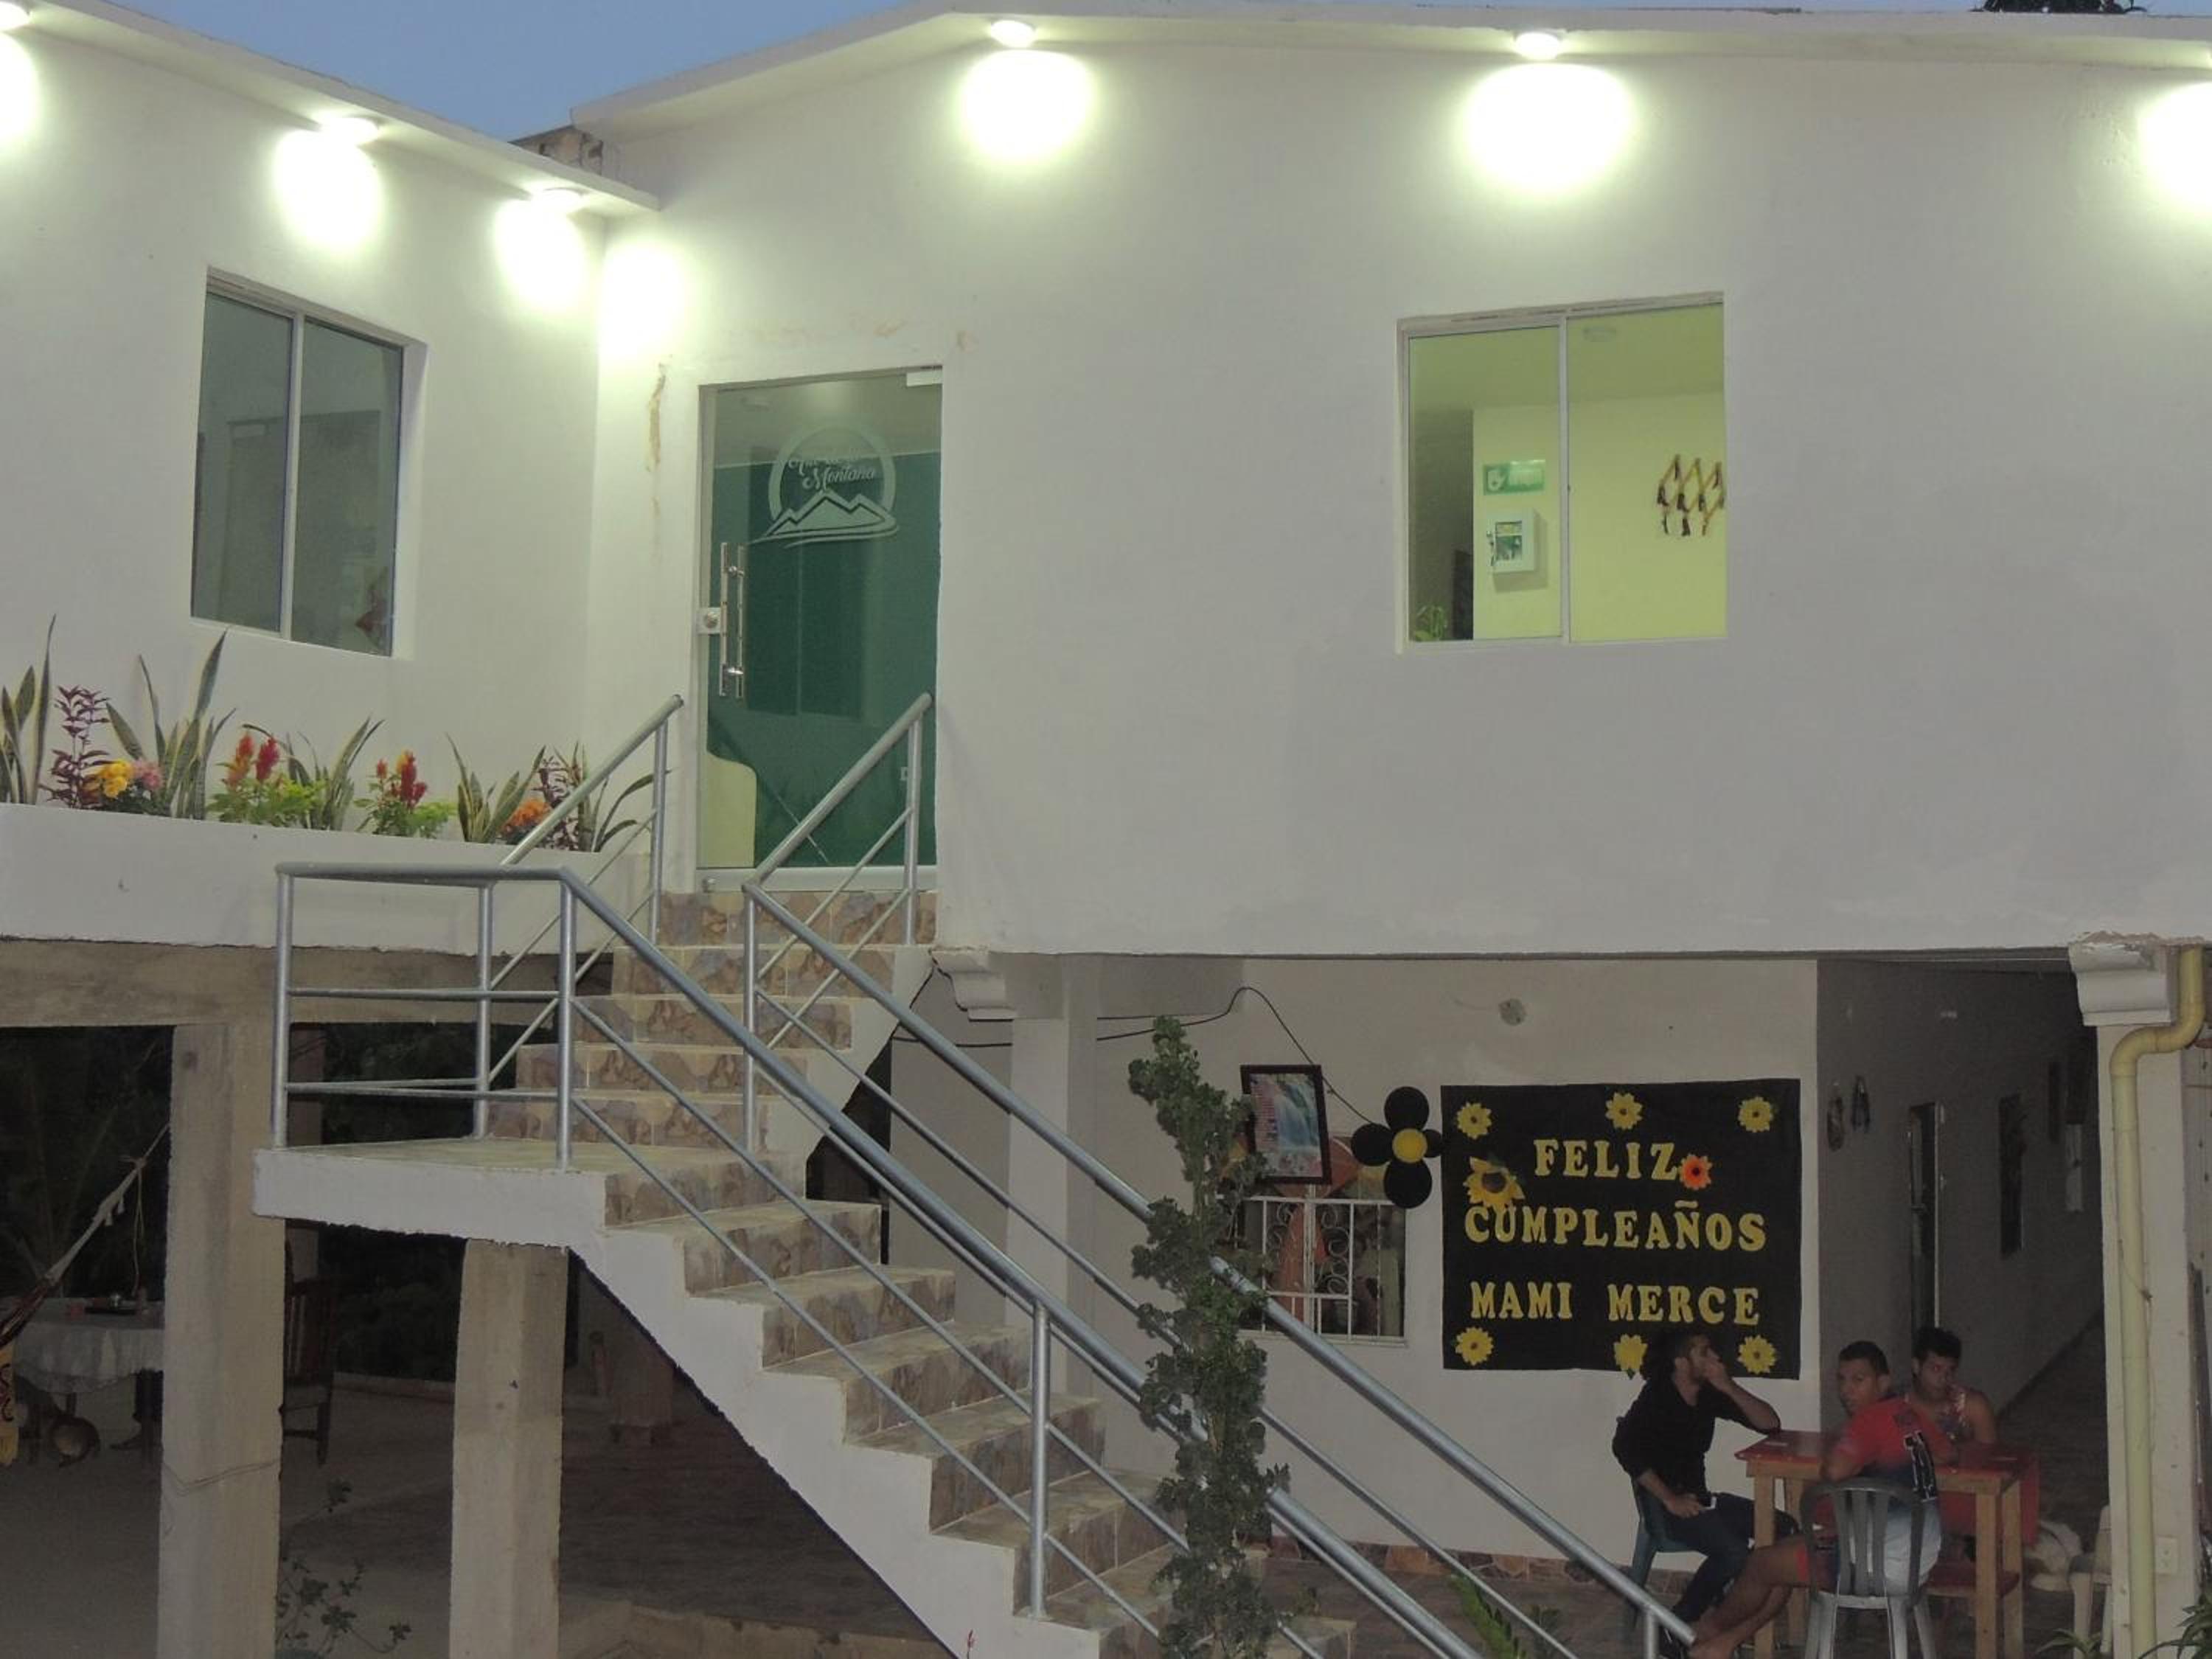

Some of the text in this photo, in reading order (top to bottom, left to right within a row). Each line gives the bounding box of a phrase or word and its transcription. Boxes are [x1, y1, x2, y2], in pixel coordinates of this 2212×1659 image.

[1533, 1138, 1677, 1180] FELIZ
[1464, 1200, 1766, 1252] CUMPLEAÑOS
[1470, 1281, 1760, 1326] MAMI MERCE
